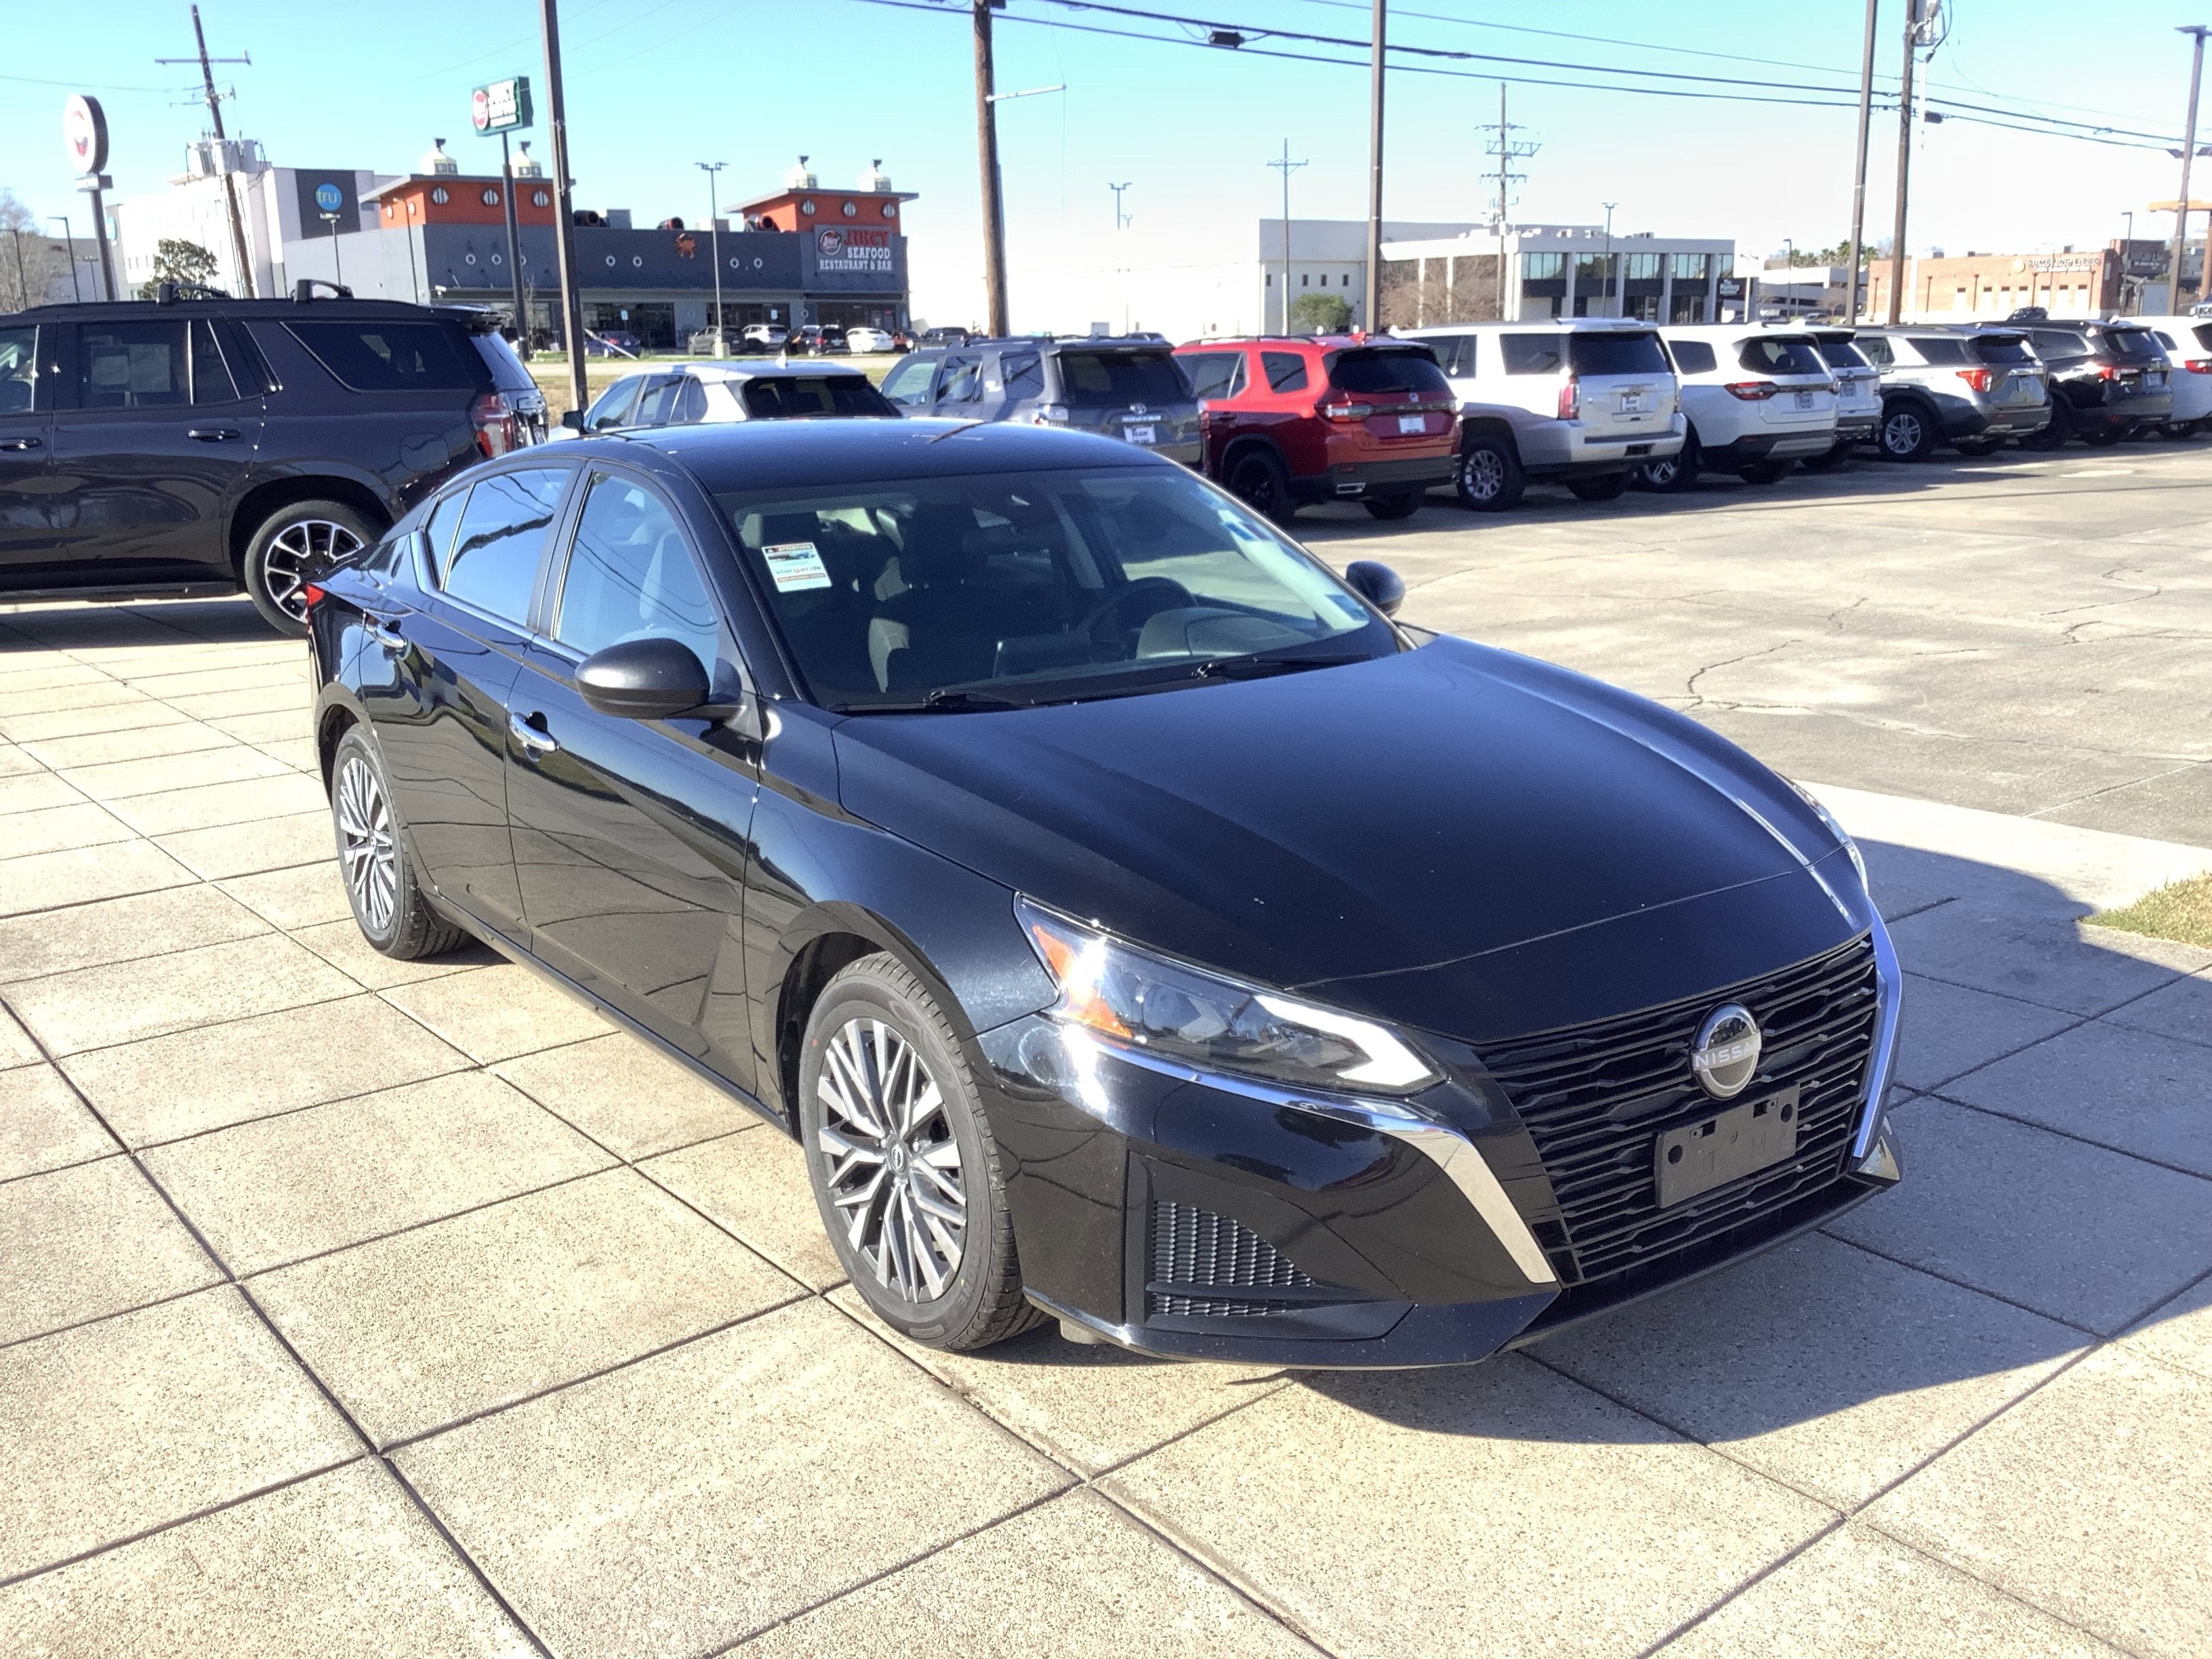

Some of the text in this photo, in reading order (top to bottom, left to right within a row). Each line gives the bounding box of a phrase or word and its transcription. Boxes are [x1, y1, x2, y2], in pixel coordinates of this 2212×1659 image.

[316, 190, 337, 203] tru
[845, 230, 888, 245] JUICY
[847, 247, 890, 259] SEAFOOD
[819, 260, 892, 270] RESTAURANT & BAR
[1696, 1038, 1759, 1067] NISSA
